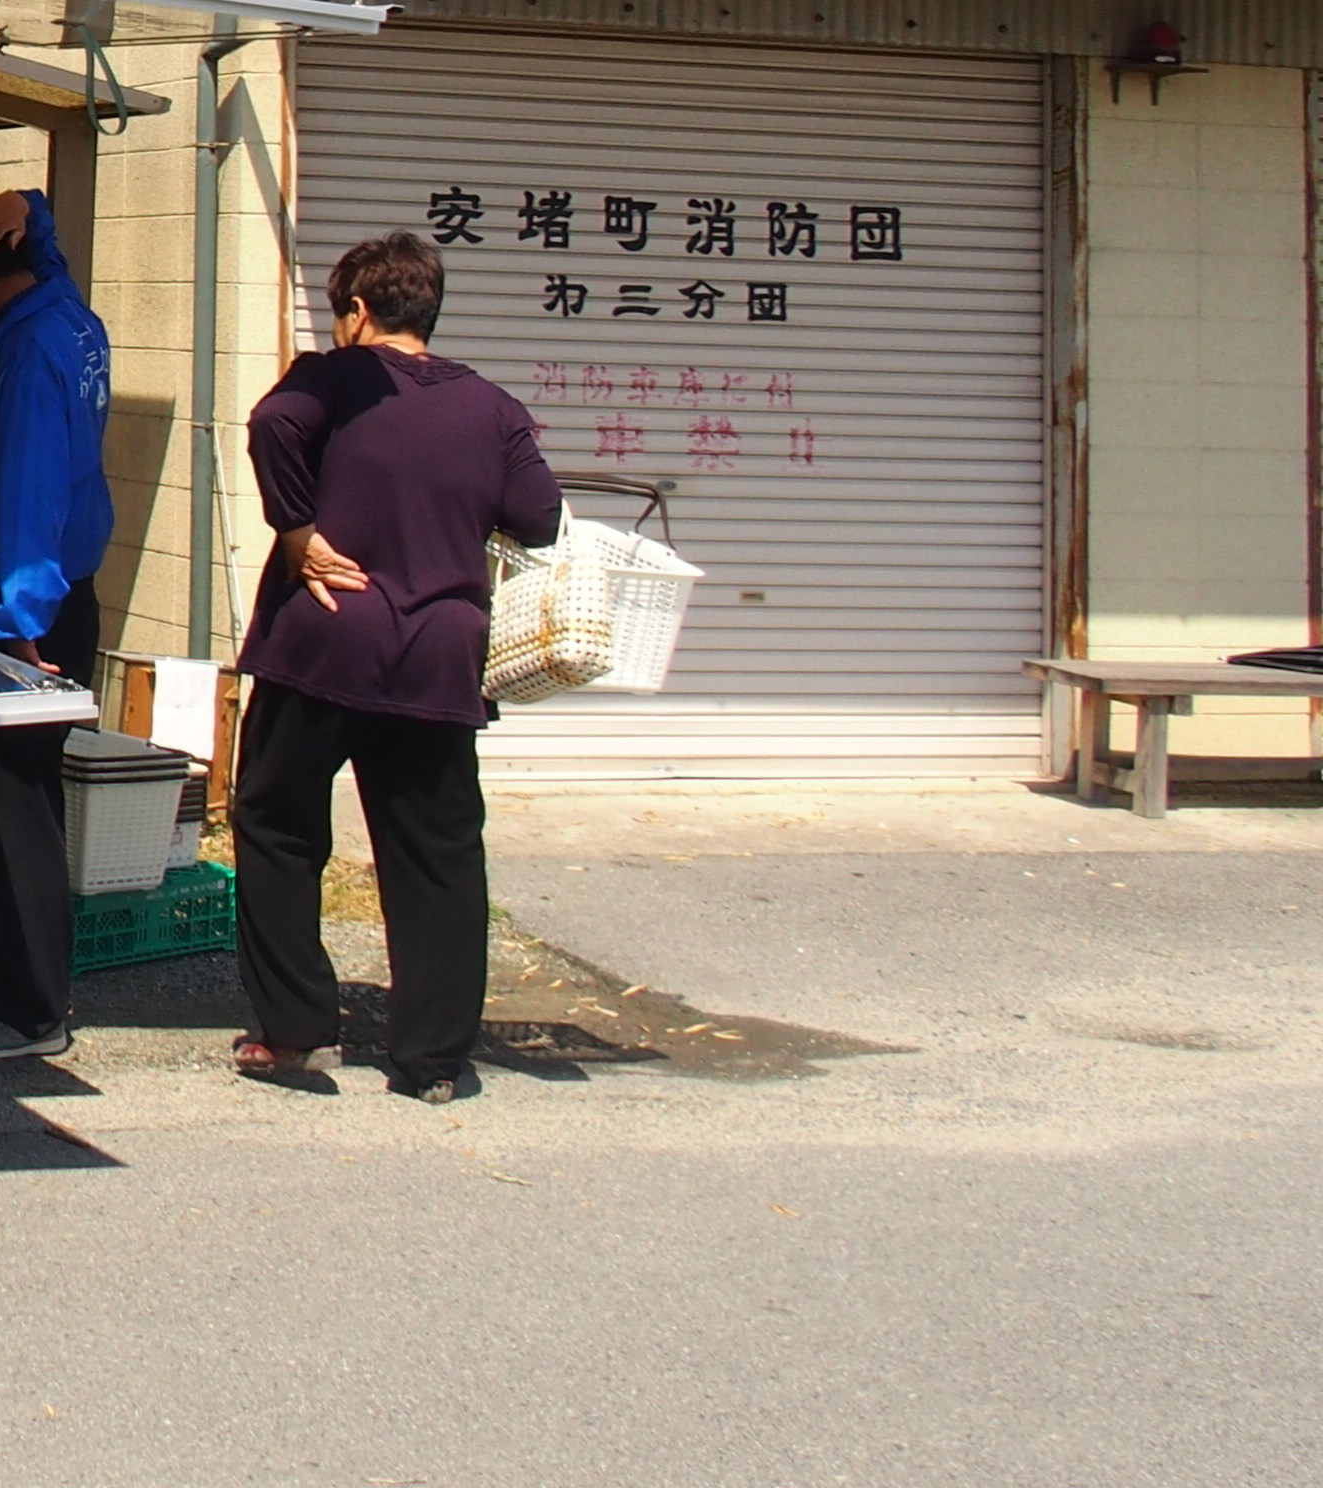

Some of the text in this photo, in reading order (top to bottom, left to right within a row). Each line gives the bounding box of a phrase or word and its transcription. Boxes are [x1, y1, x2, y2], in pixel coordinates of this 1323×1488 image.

[426, 186, 903, 262] 安堵町消防団
